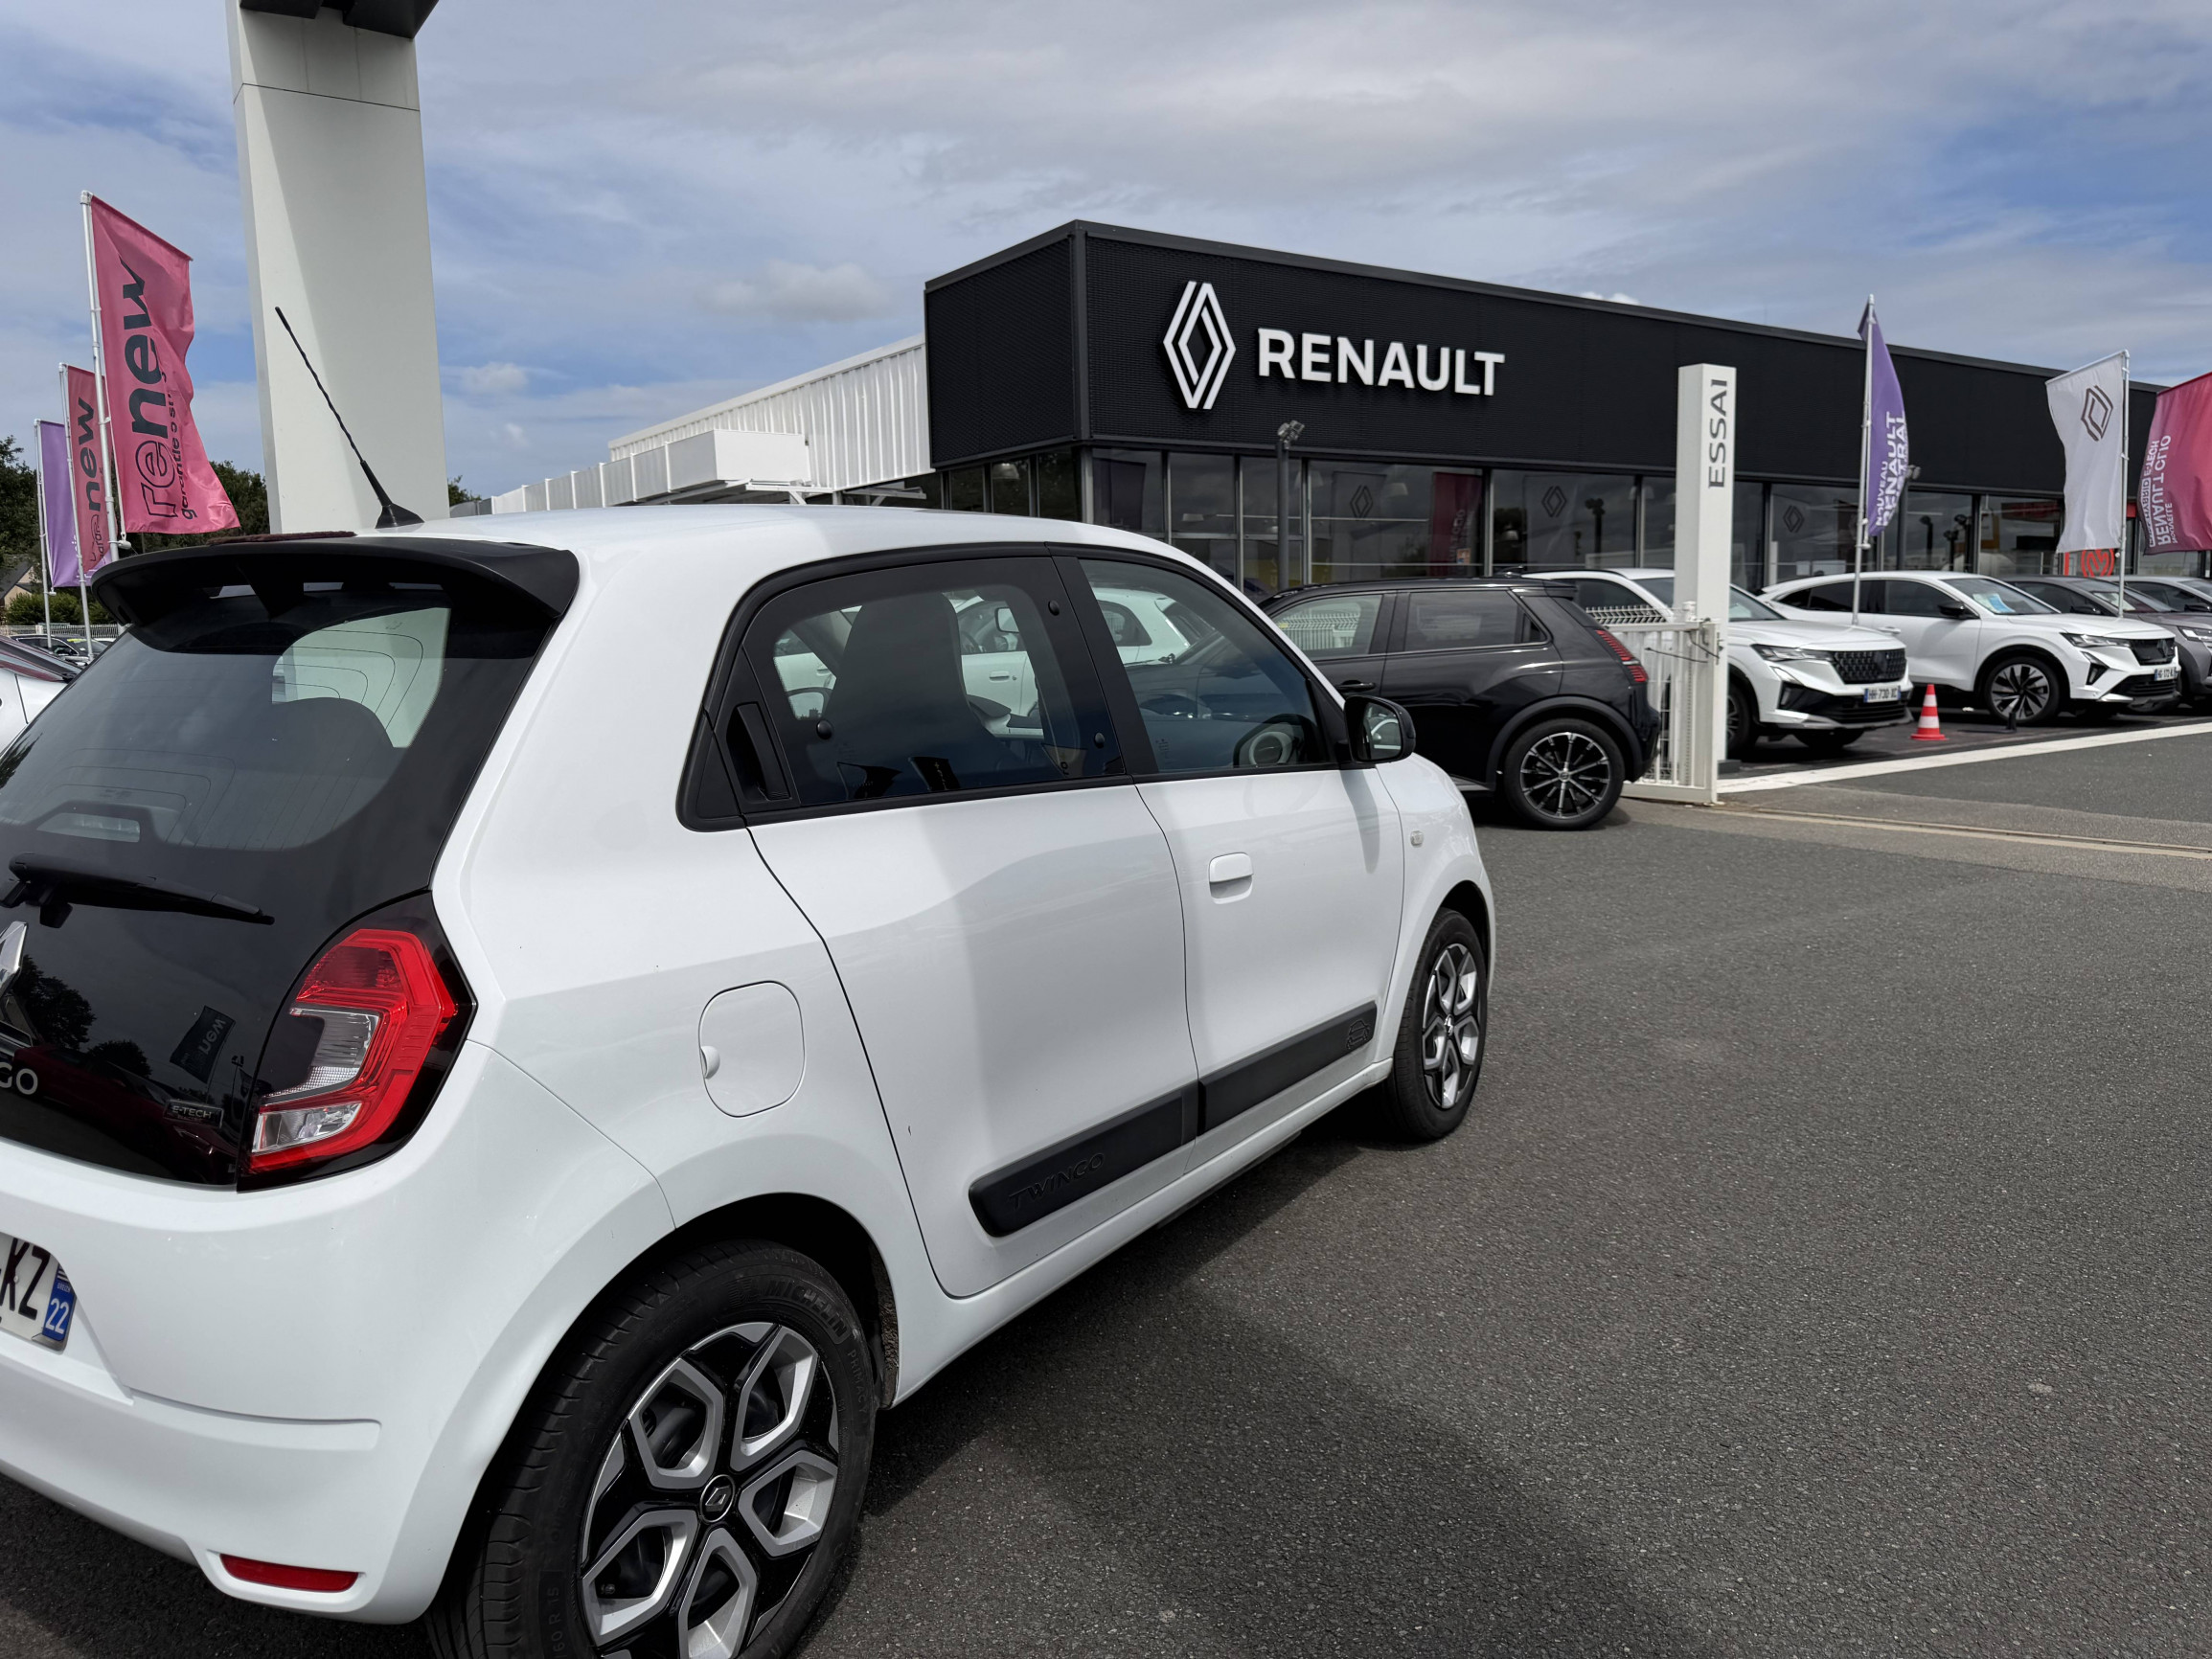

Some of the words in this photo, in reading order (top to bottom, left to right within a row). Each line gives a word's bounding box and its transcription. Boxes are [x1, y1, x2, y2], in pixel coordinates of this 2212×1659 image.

[120, 256, 179, 518] renew
[1258, 328, 1506, 397] RENAULT
[1708, 378, 1728, 489] ESSAI
[172, 1105, 212, 1119] E-TECH
[1007, 1152, 1106, 1210] TWINGO
[45, 1297, 70, 1334] 22
[765, 1279, 849, 1339] MICHELIN
[847, 1348, 869, 1415] PRIMACY
